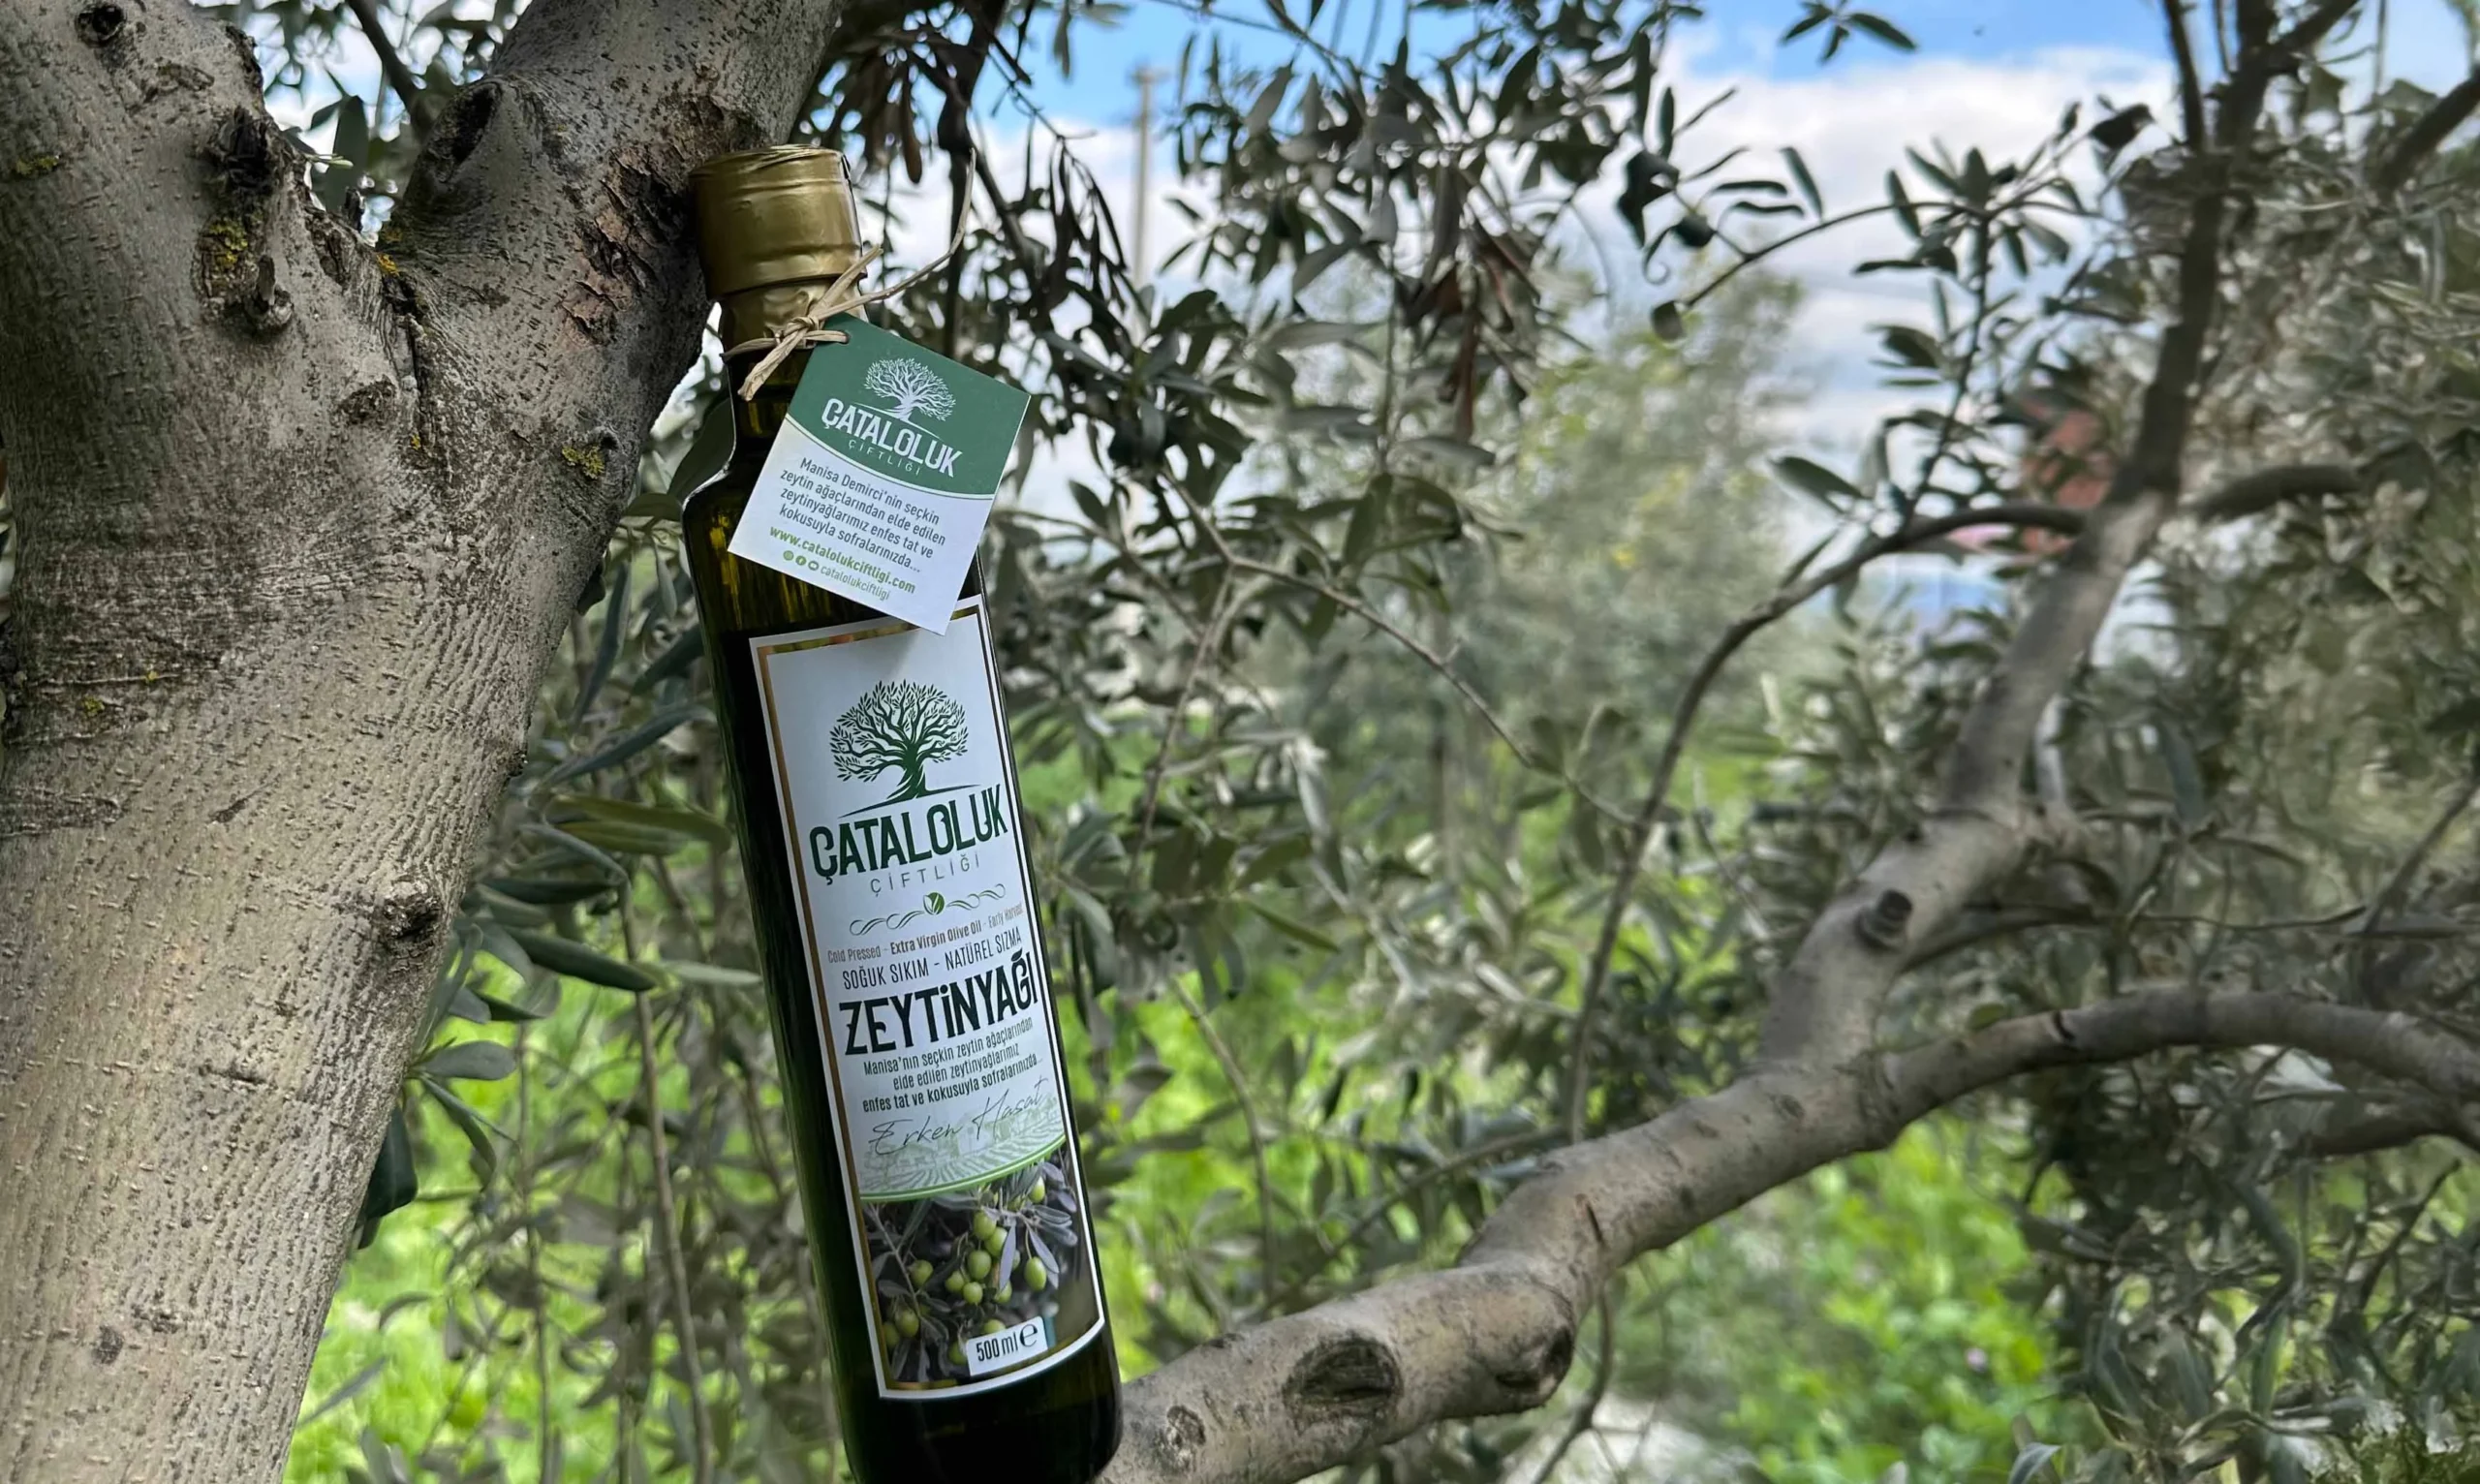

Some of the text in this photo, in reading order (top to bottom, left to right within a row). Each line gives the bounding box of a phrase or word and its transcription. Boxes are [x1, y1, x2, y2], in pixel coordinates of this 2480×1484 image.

[821, 397, 963, 478] ÇATALOLUK
[779, 504, 836, 537] kokusuyla
[780, 469, 946, 546] zeytin ağaçlarından elde edilen
[780, 487, 934, 559] zeytinyağlarımız enfes tat ve
[800, 457, 940, 525] Manisa Demirci'nin seçkin
[769, 526, 915, 594] www.catalolukciftligi.com
[821, 565, 891, 602] catalolukciftligi
[809, 784, 1008, 885] ÇATALOLUK
[827, 948, 847, 964] Cold
[848, 945, 882, 962] Pressed
[890, 939, 916, 955] Extra
[916, 931, 946, 948] Virgin
[947, 925, 970, 943] Olive
[970, 919, 982, 935] Oil
[988, 913, 1005, 929] Early
[842, 964, 886, 990] SOĞUK
[889, 957, 929, 983] SIKIM
[945, 938, 994, 972] NATÜREL
[995, 926, 1022, 954] SIZMA
[893, 1043, 1020, 1091] elde edilen zeytinyağlarımız
[922, 1047, 954, 1069] seçkin
[957, 1038, 984, 1060] zeytin
[986, 1016, 1034, 1049] ağaçlarından
[862, 1097, 892, 1113] enfes
[894, 1095, 910, 1110] tat
[912, 1092, 924, 1107] ve
[927, 1078, 980, 1103] kokusuyla
[868, 1074, 1049, 1156] Erken Hasat
[976, 1338, 1000, 1362] 500
[1002, 1330, 1018, 1355] ml
